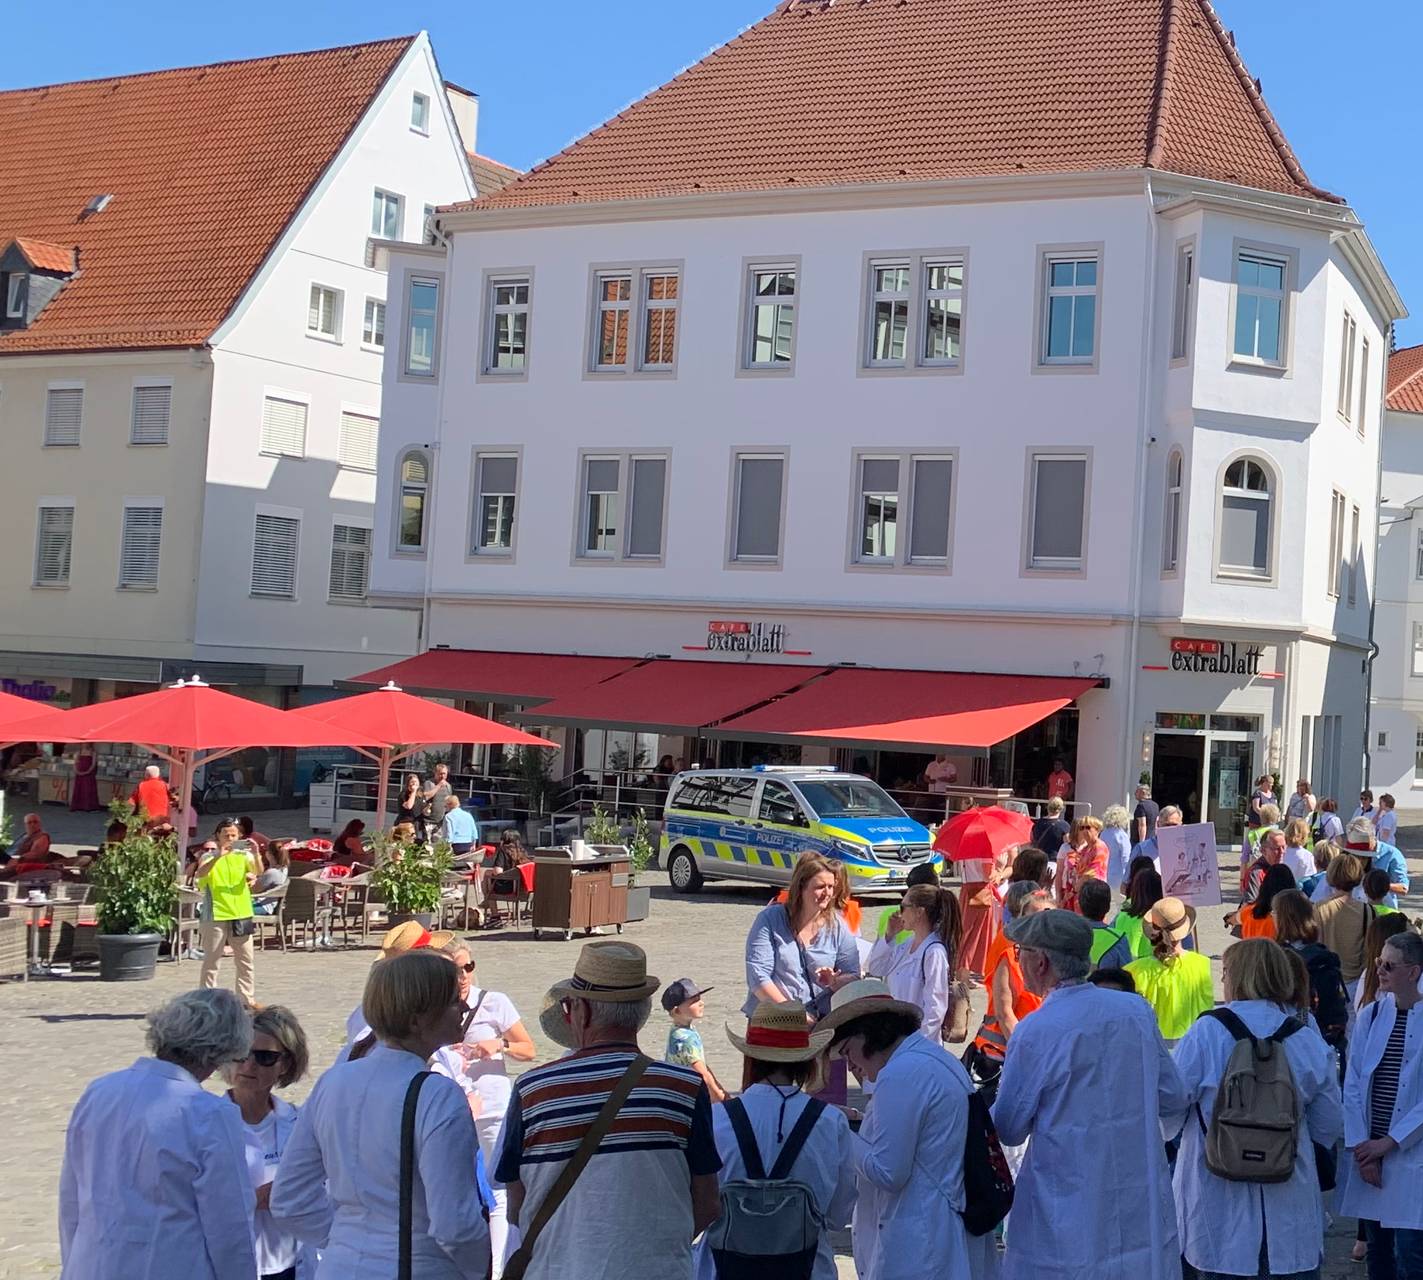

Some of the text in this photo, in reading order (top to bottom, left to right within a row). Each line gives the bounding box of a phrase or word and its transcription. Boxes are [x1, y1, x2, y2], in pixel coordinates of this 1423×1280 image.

[706, 622, 785, 653] extrablatt
[1174, 640, 1217, 652] CAFE
[1171, 642, 1264, 676] extrablatt
[756, 832, 785, 845] POLIZEI
